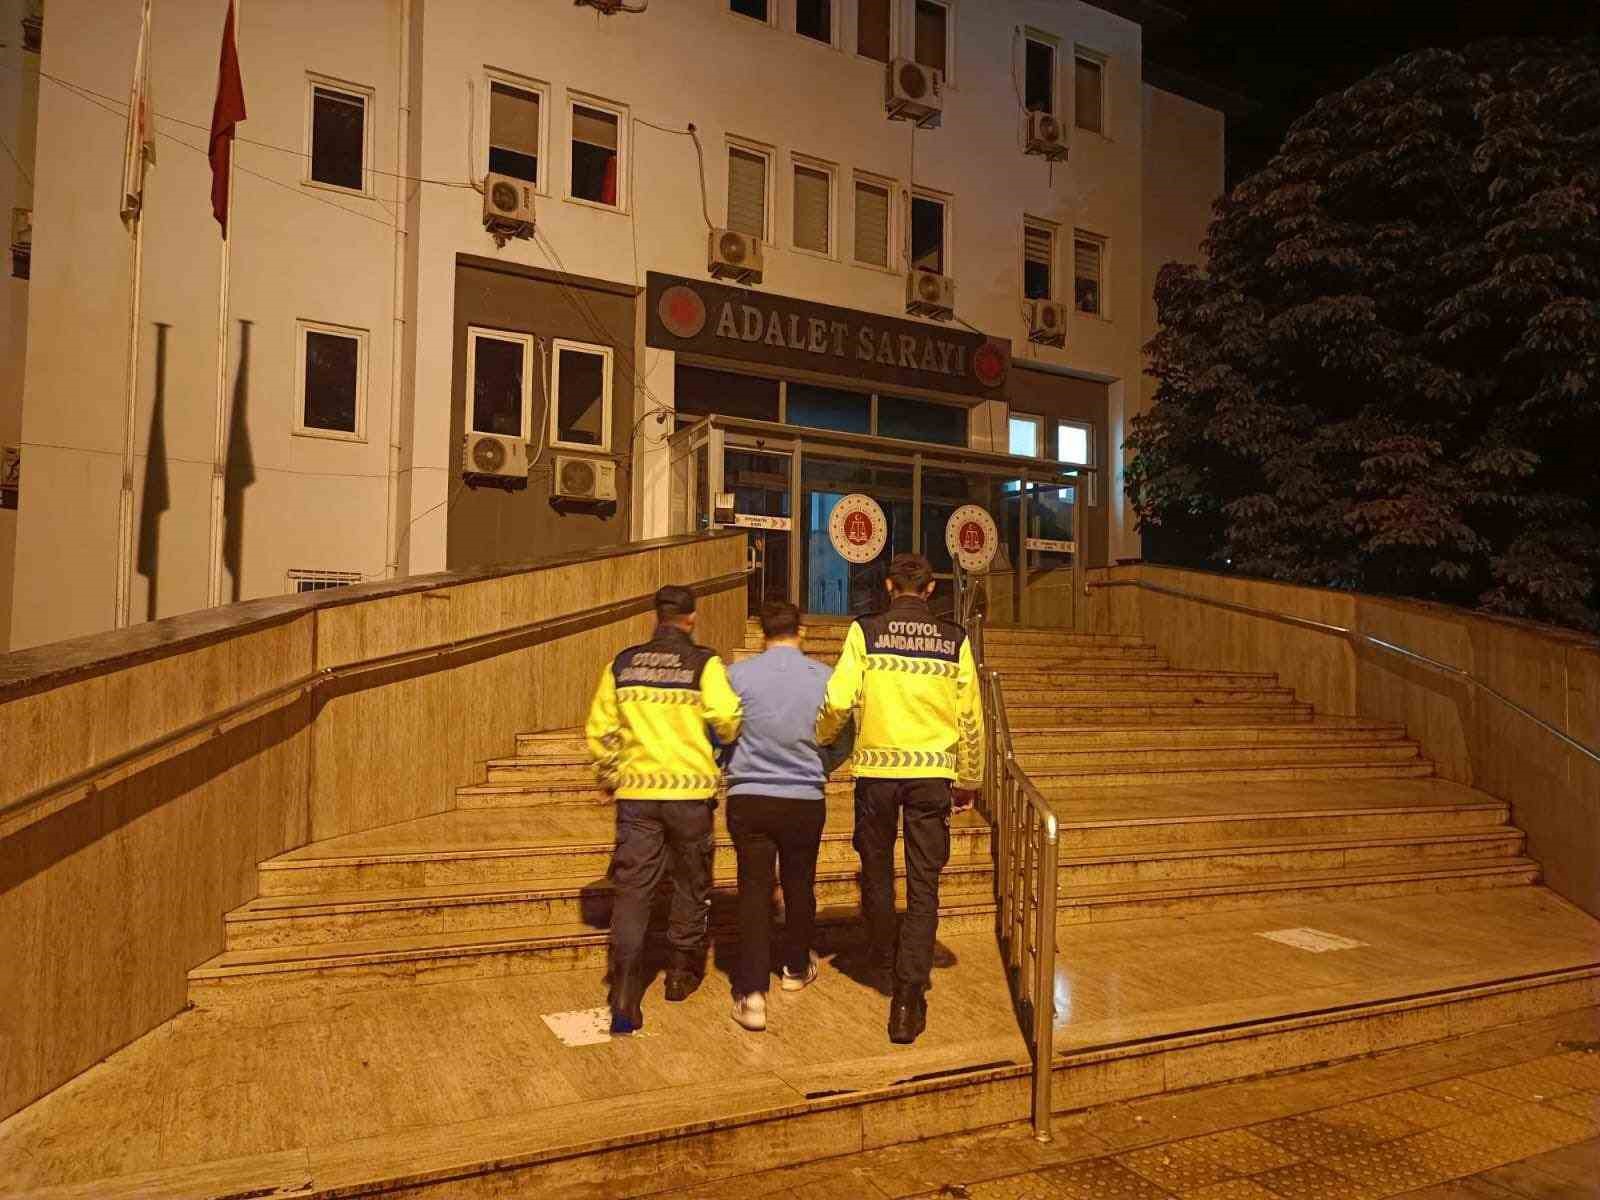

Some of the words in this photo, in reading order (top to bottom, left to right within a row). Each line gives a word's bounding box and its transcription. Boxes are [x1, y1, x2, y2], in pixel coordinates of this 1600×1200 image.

[716, 301, 850, 358] ADALET
[856, 326, 966, 376] SARAYI
[888, 621, 942, 637] OTOYOL
[875, 634, 955, 655] JANDARMASI
